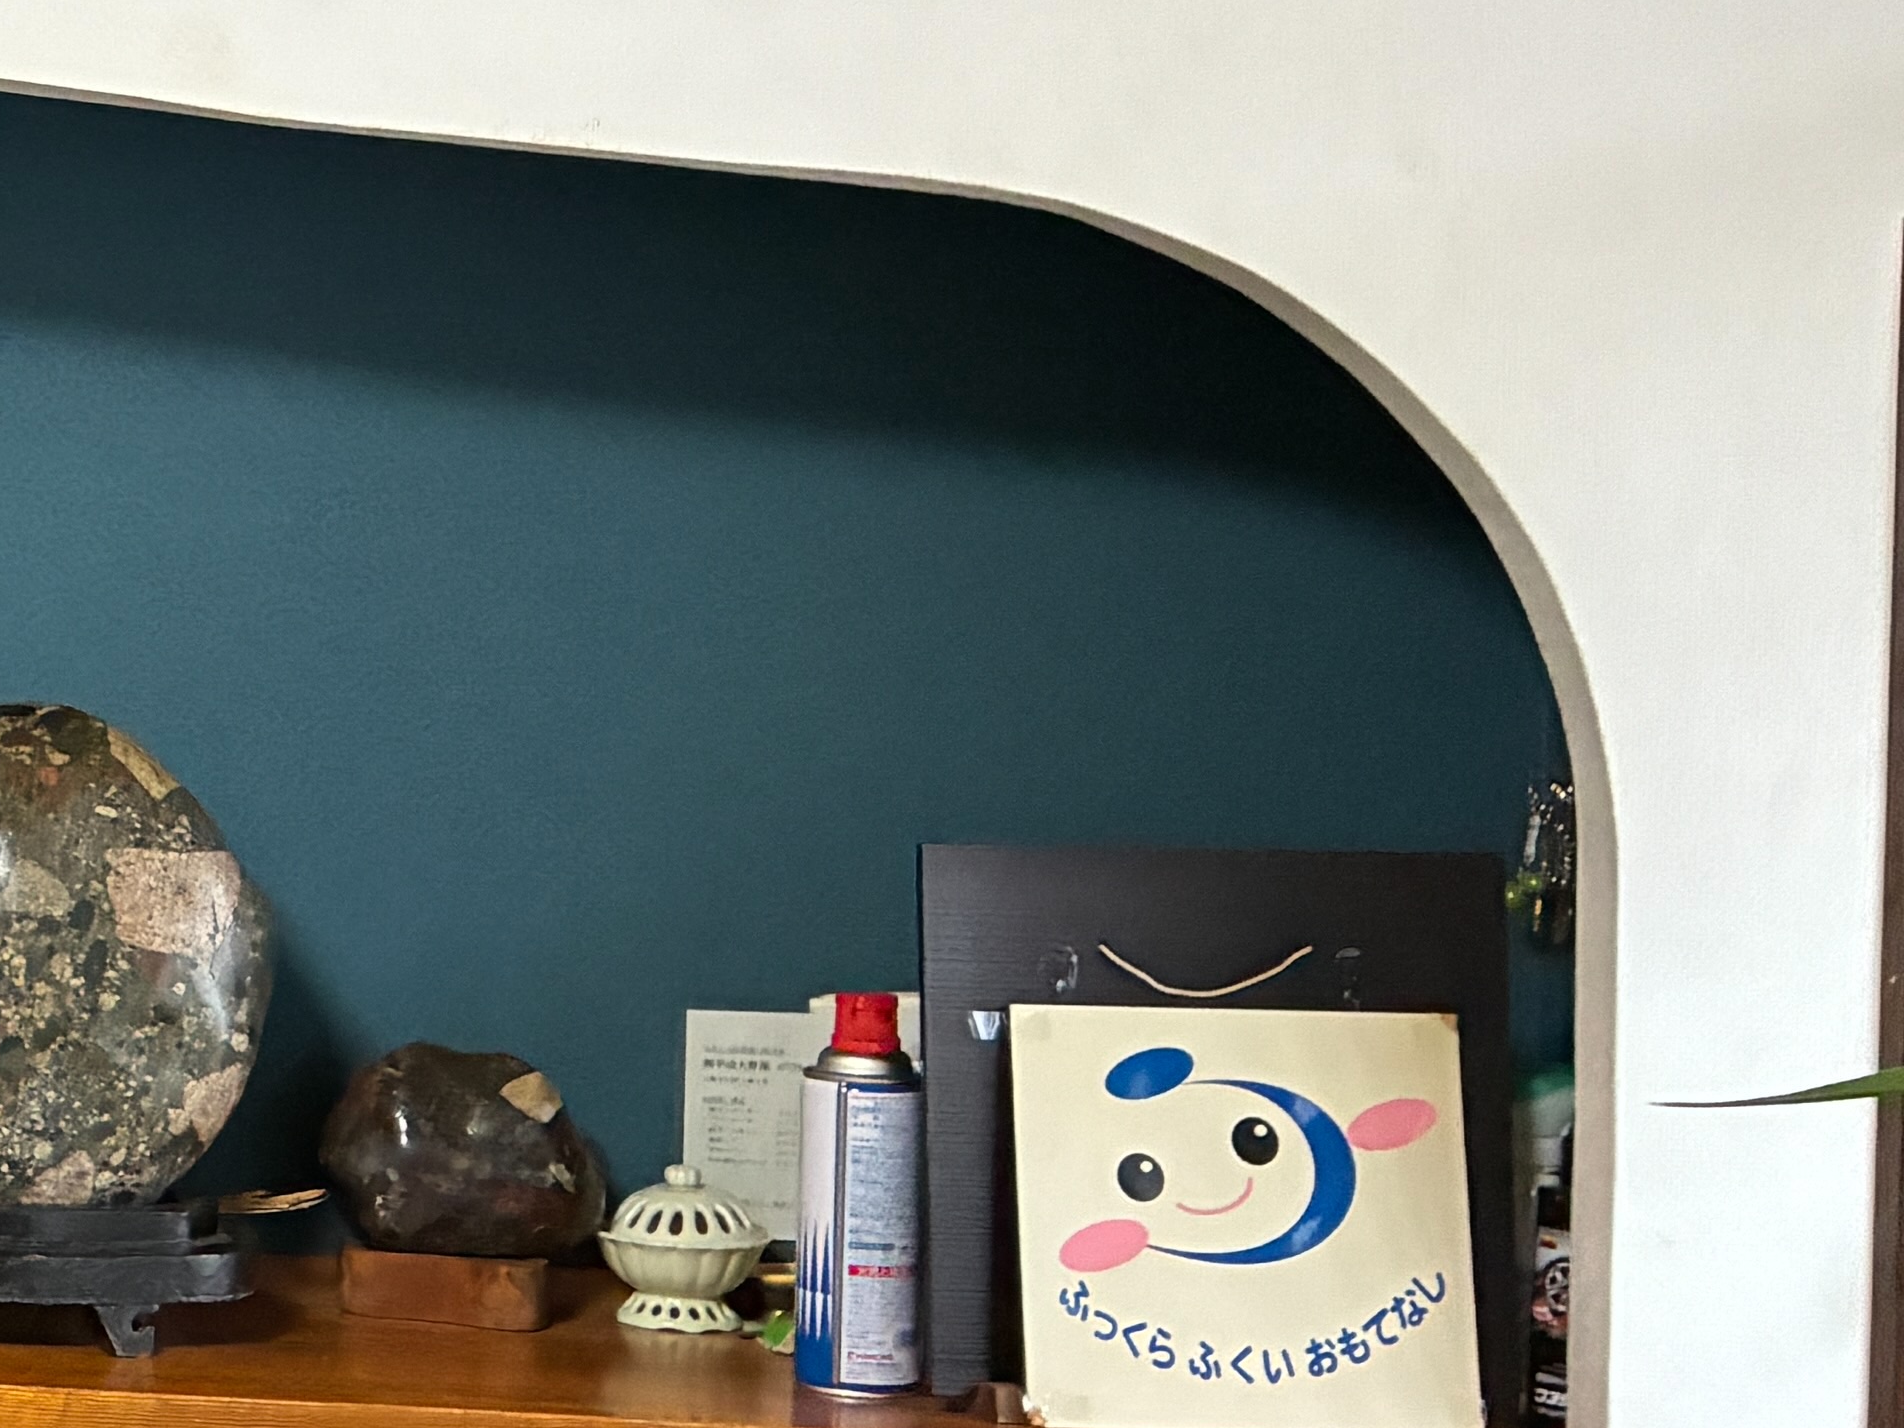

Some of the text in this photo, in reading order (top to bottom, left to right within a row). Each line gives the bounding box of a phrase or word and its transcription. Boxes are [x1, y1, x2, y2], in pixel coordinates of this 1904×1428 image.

[1189, 1340, 1296, 1385] ふくい
[1304, 1271, 1446, 1378] おもてなし
